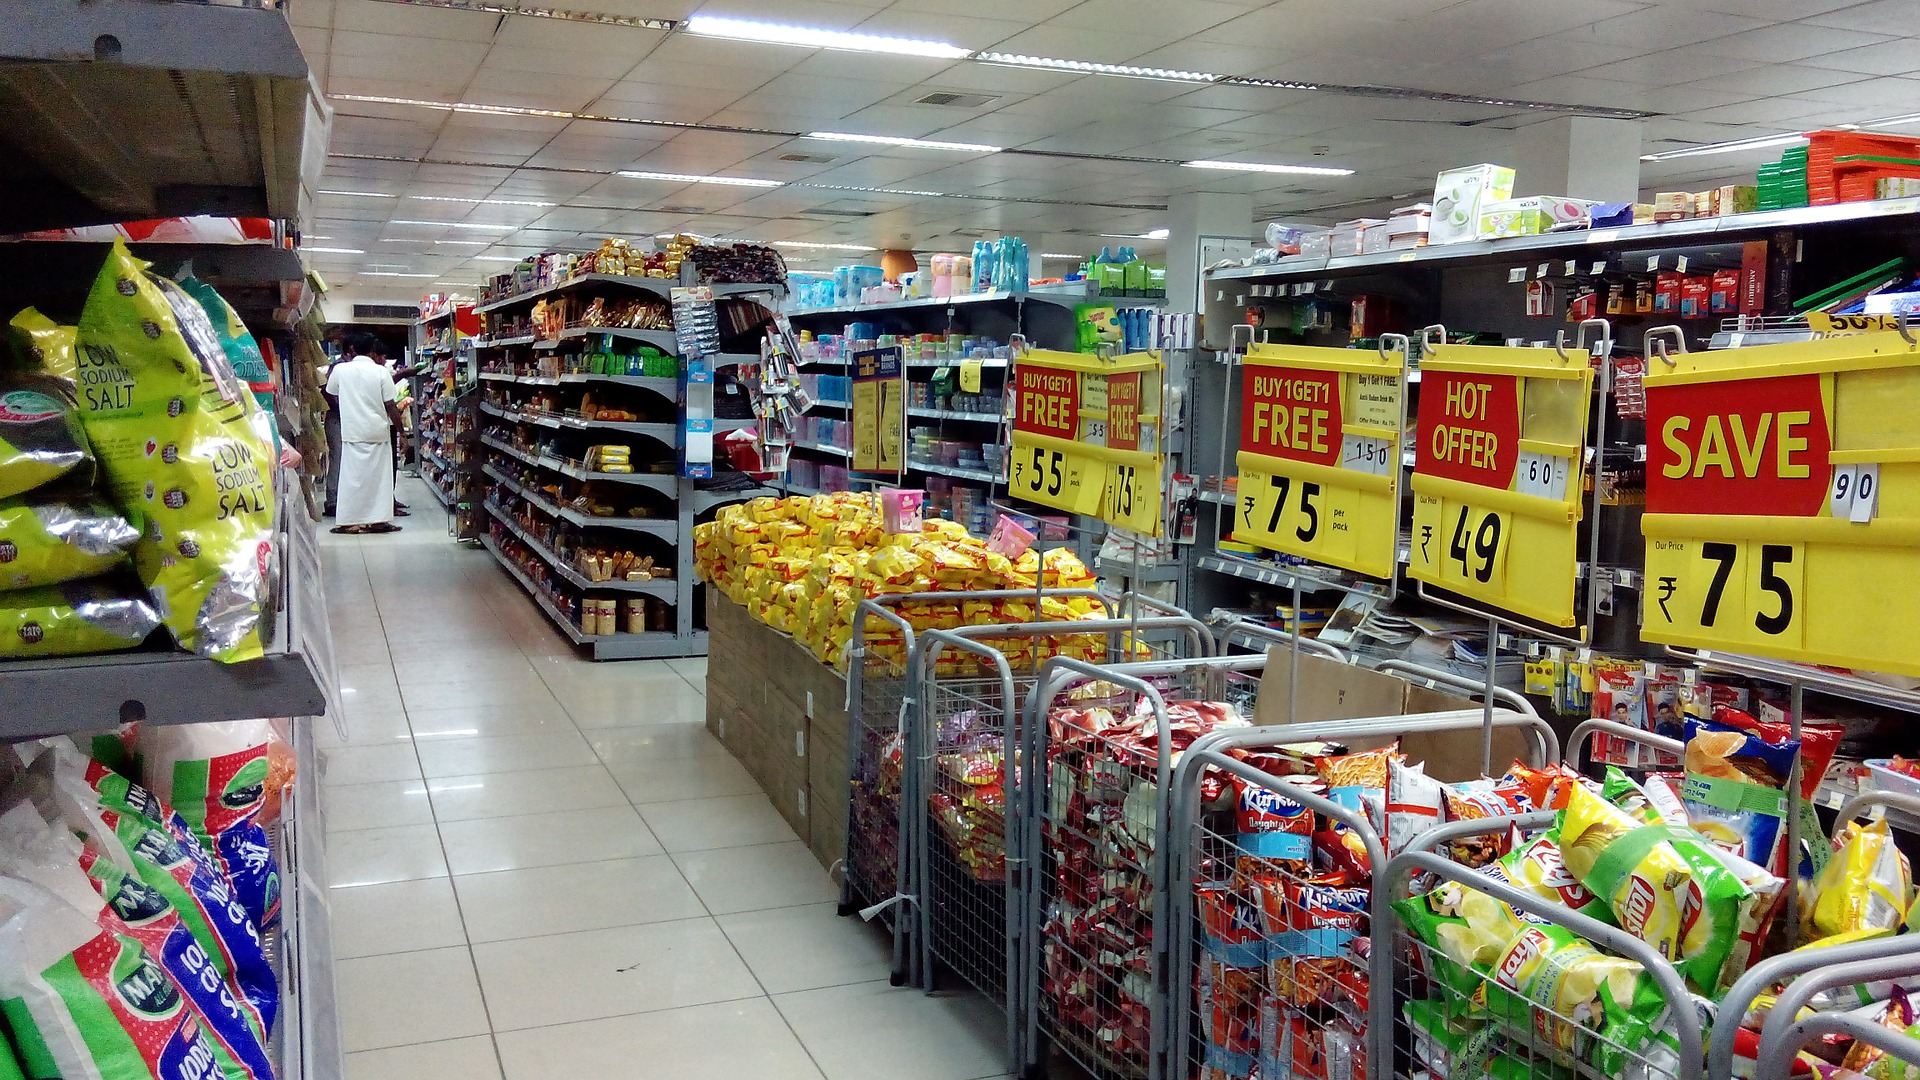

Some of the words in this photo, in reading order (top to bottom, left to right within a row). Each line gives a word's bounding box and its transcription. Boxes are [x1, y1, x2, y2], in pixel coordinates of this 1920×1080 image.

[74, 344, 121, 368] LOW
[80, 368, 134, 386] SODIUM
[86, 384, 135, 411] SALT
[1022, 391, 1071, 430] FREE
[1445, 380, 1493, 421] HOT
[1110, 404, 1135, 441] FREE
[1252, 402, 1329, 454] FREE
[212, 441, 252, 474] LOW
[1356, 442, 1387, 466] 150
[1431, 423, 1498, 471] OFFER
[1661, 410, 1811, 479] SAVE
[216, 466, 261, 494] SODIUM
[1030, 447, 1064, 497] 55
[1243, 471, 1252, 479] Our
[1252, 472, 1260, 480] Price
[1529, 460, 1551, 485] 60
[1834, 473, 1874, 500] 90
[217, 484, 266, 521] SALT
[1117, 465, 1134, 517] 75
[1427, 497, 1437, 506] Price
[1267, 475, 1320, 543] 75
[1333, 508, 1345, 519] per
[1332, 521, 1349, 533] pack
[1449, 504, 1501, 583] 49
[1655, 541, 1667, 551] Our
[1667, 542, 1684, 552] Price
[1699, 541, 1793, 635] 75
[1249, 816, 1284, 830] Naughty
